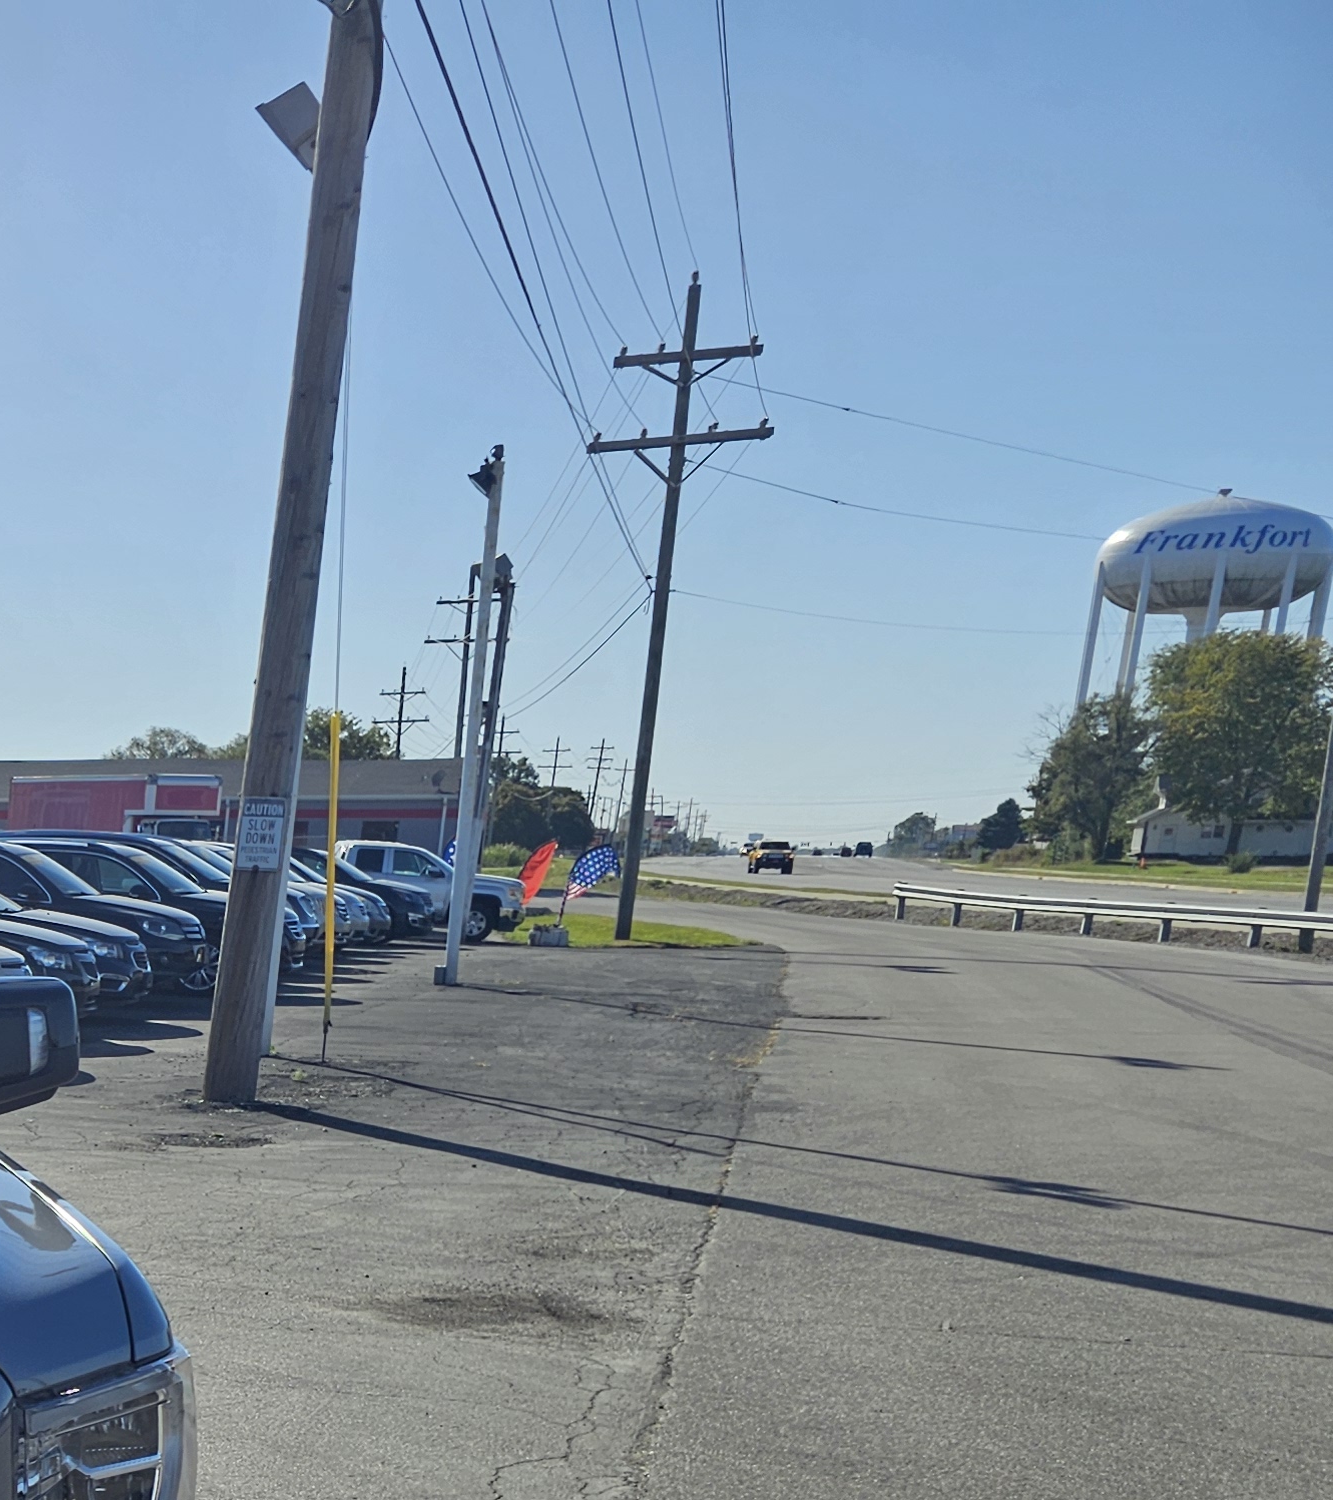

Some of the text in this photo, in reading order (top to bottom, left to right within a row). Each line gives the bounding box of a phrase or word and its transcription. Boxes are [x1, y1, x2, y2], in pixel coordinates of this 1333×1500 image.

[1134, 524, 1312, 554] Frankfort
[244, 803, 284, 816] CAUTION
[248, 818, 277, 831] SLOW
[245, 832, 276, 845] DOWN
[245, 855, 270, 864] TRAFFIC
